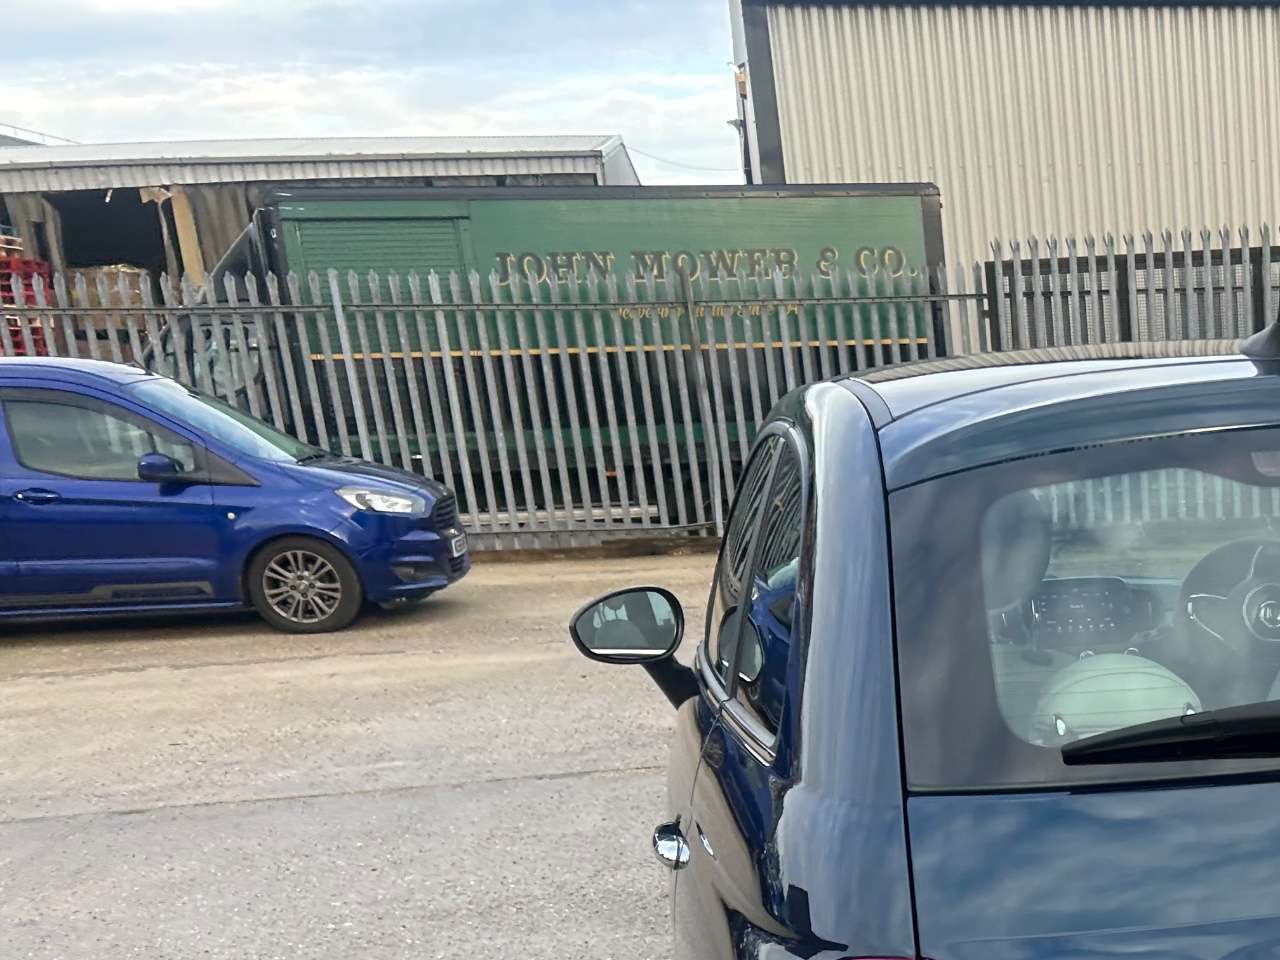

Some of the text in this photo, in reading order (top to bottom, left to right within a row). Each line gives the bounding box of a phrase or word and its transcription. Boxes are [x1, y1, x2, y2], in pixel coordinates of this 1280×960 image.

[495, 251, 615, 286] JOHN
[631, 248, 798, 282] MOWER
[816, 247, 839, 280] &
